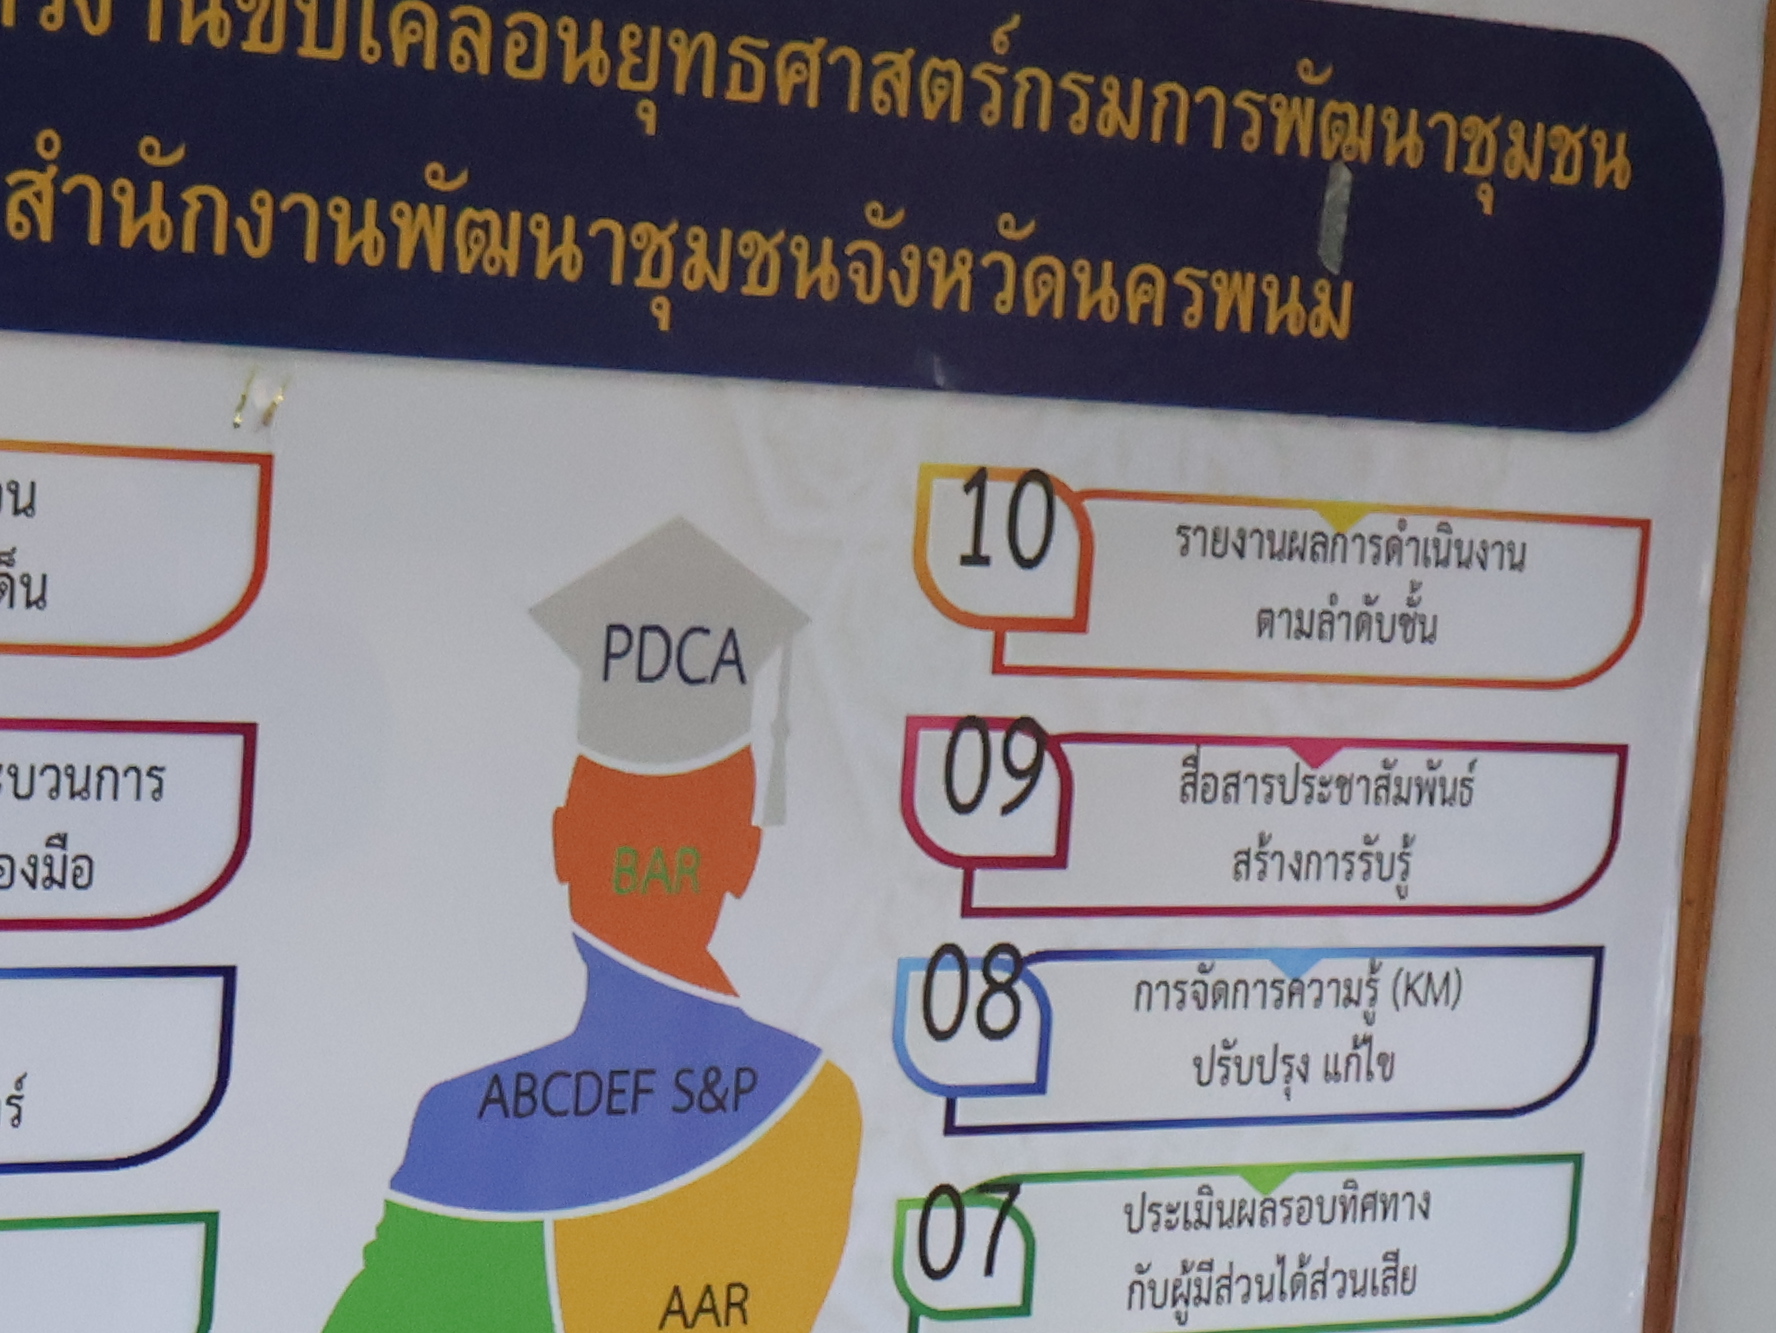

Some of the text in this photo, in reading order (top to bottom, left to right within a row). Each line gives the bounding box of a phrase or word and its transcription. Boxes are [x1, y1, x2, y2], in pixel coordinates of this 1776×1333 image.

[4, 128, 1354, 340] สำนักงานพัฒนาชุมชนจังหวัดนครพนม
[960, 467, 1056, 569] 10
[1176, 518, 1527, 573] รายงานผลการดำเนินงาน
[1257, 579, 1438, 644] ตามลำดับชั้น
[602, 623, 747, 686] PDCA
[944, 715, 1048, 816] 09
[1180, 746, 1477, 807] สื่อสารประชาสัมพันธ์
[613, 846, 701, 895] BAR
[1233, 831, 1416, 901] สร้างการรับรู้
[922, 943, 1025, 1041] 08
[1134, 959, 1462, 1027] การจัดการความรู้ (KM)
[478, 1065, 758, 1119] ABCDEF S&P
[1192, 1033, 1395, 1101] ปรับปรุง แก้ไข
[918, 1178, 1023, 1281] 07
[1122, 1176, 1431, 1234] ประเมินผลรอบทิศทาง
[658, 1282, 749, 1330] AAR
[1127, 1248, 1417, 1325] กับผู้มีส่วนได้ส่วนเสีย
